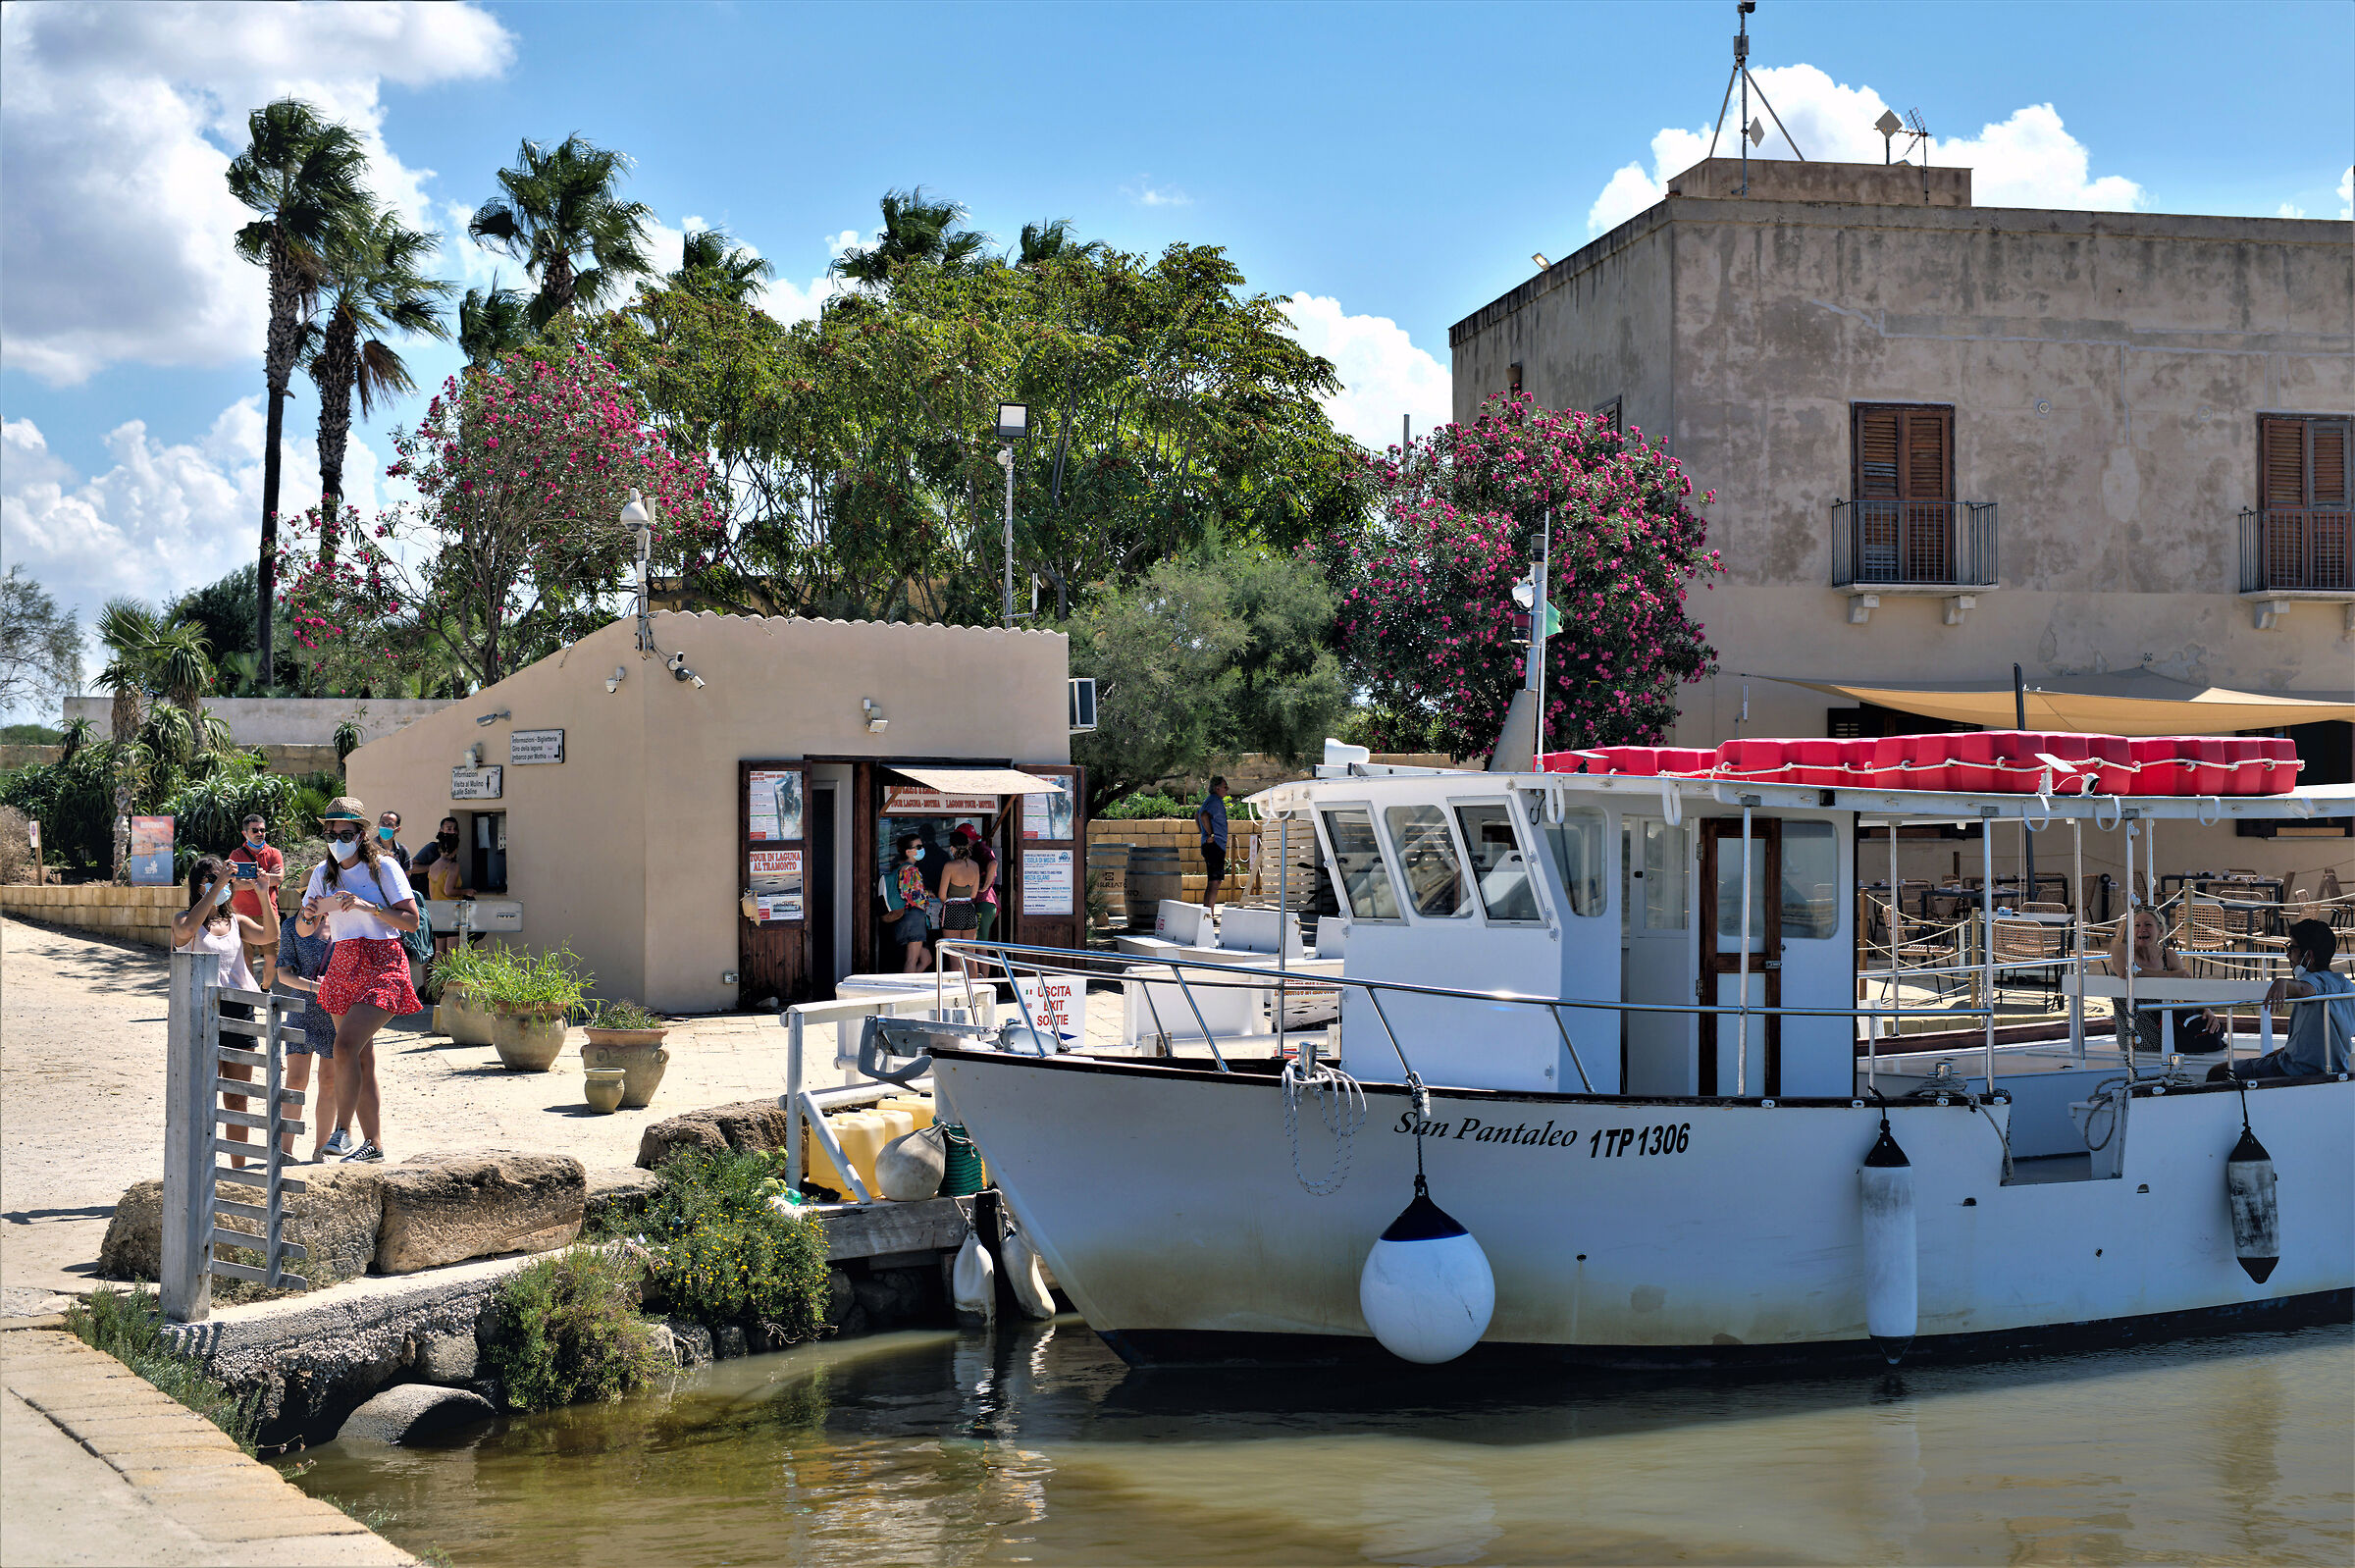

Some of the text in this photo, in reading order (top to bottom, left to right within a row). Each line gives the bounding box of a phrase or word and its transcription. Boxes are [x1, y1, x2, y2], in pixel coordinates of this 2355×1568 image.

[924, 800, 941, 808] MOTHIA
[946, 800, 964, 808] LAGOON
[965, 800, 976, 808] TOUR
[978, 801, 995, 809] MOTHIA
[750, 852, 801, 862] TOUR IN LAGUNA
[754, 861, 797, 871] AL TRAMONTO
[1038, 985, 1072, 997] USCITA
[1044, 1000, 1064, 1011] EXIT
[1393, 1111, 1449, 1138] San
[1453, 1117, 1578, 1147] Pantaleo
